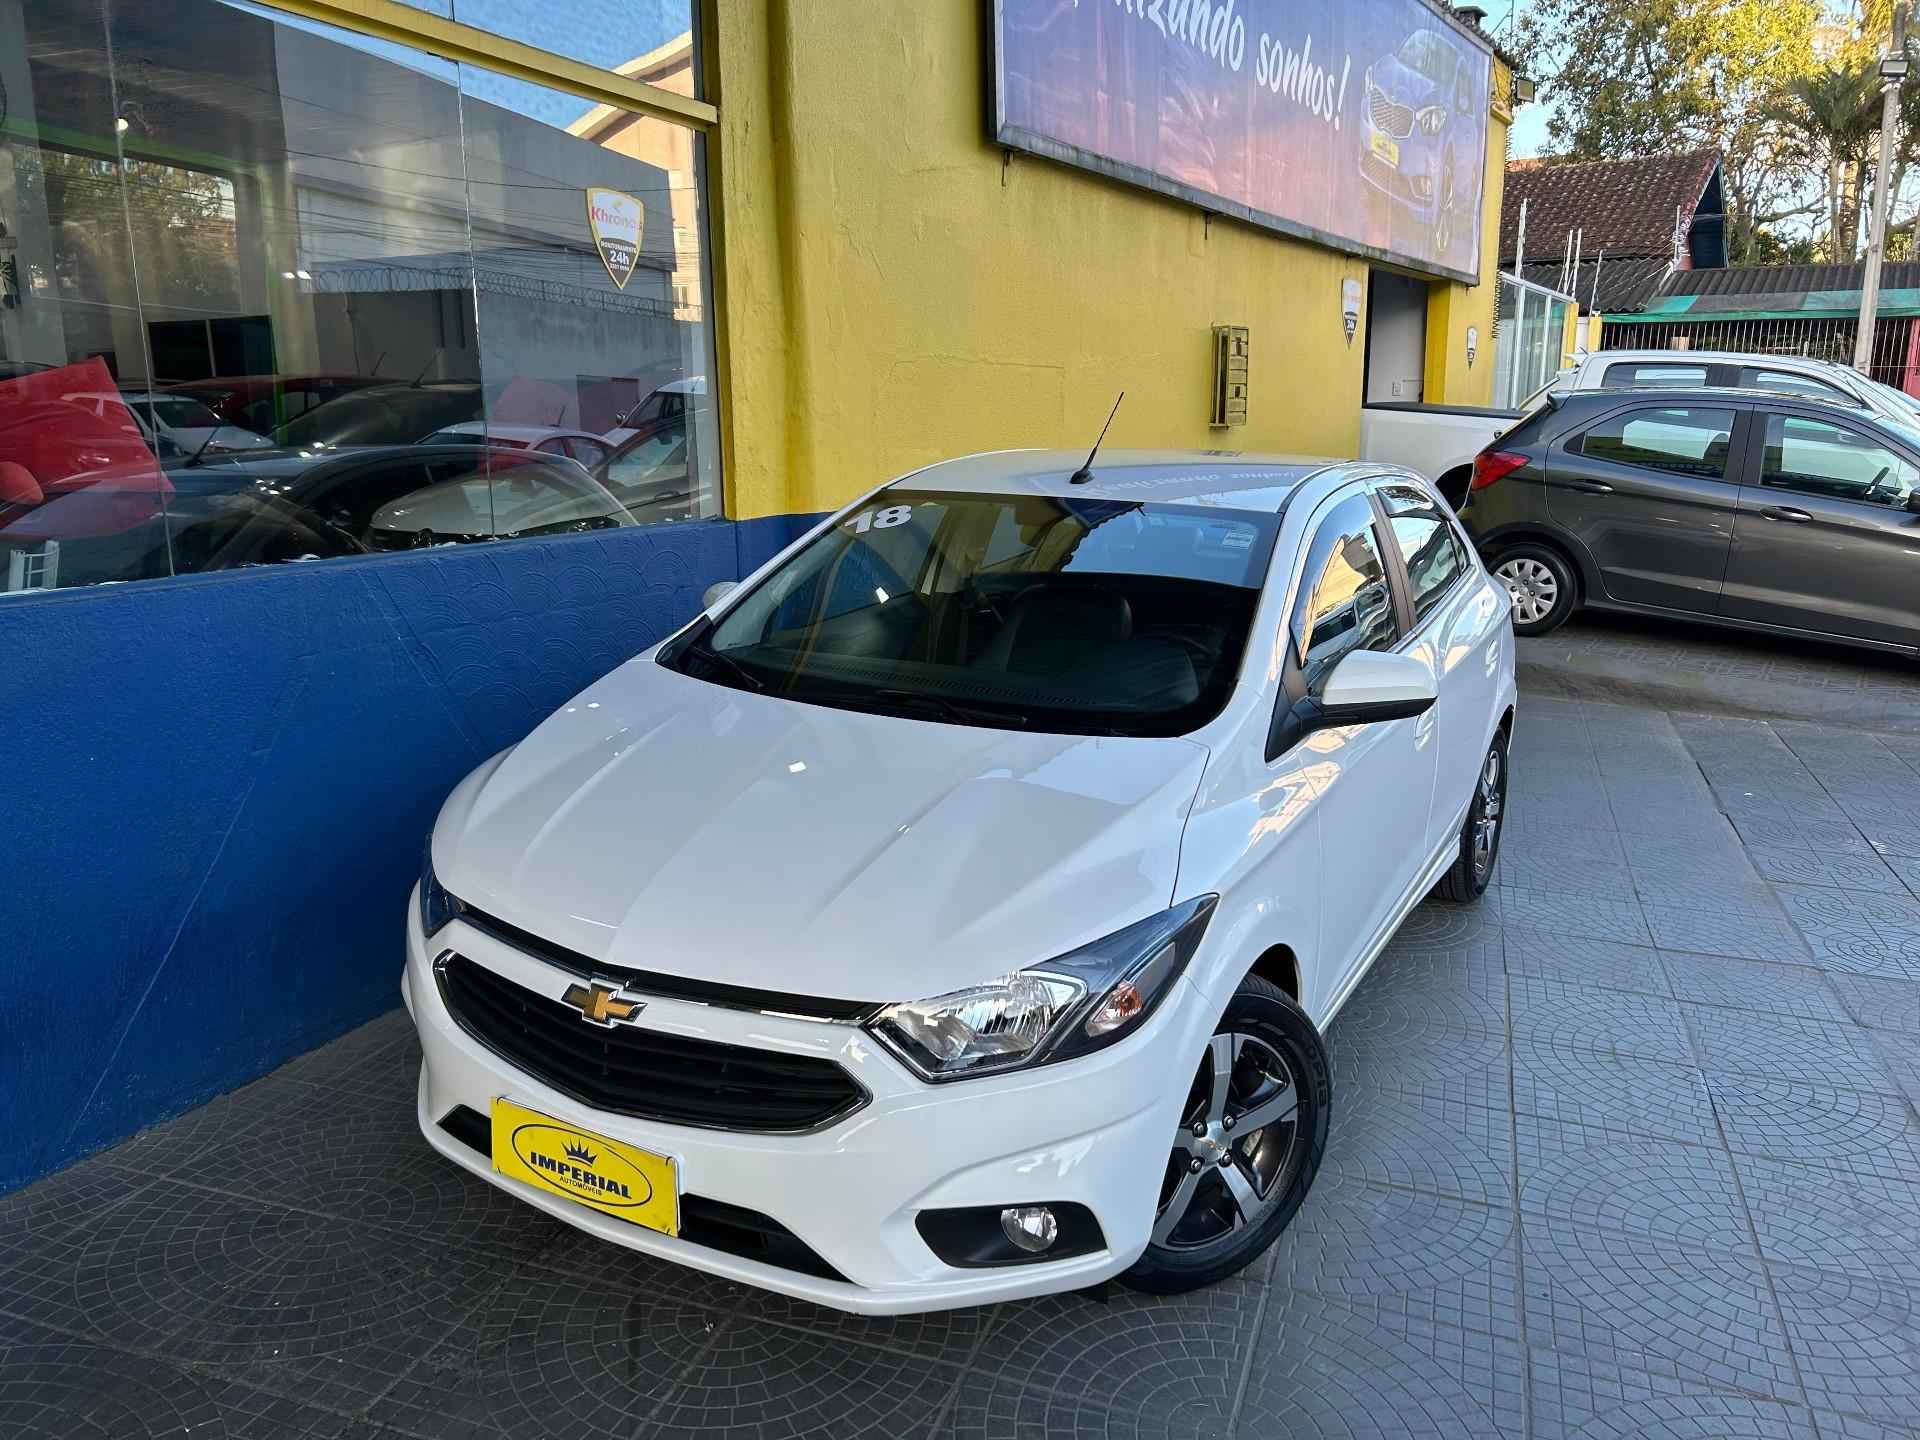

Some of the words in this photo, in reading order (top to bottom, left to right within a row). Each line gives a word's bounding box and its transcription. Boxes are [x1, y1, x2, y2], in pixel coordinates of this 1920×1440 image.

[1256, 32, 1352, 131] sonhos!
[592, 206, 644, 231] Khronos
[609, 250, 630, 265] 24h
[844, 505, 912, 534] 18
[530, 1151, 633, 1200] IMPERIAL
[559, 1176, 603, 1196] AUTOMÓVEIS
